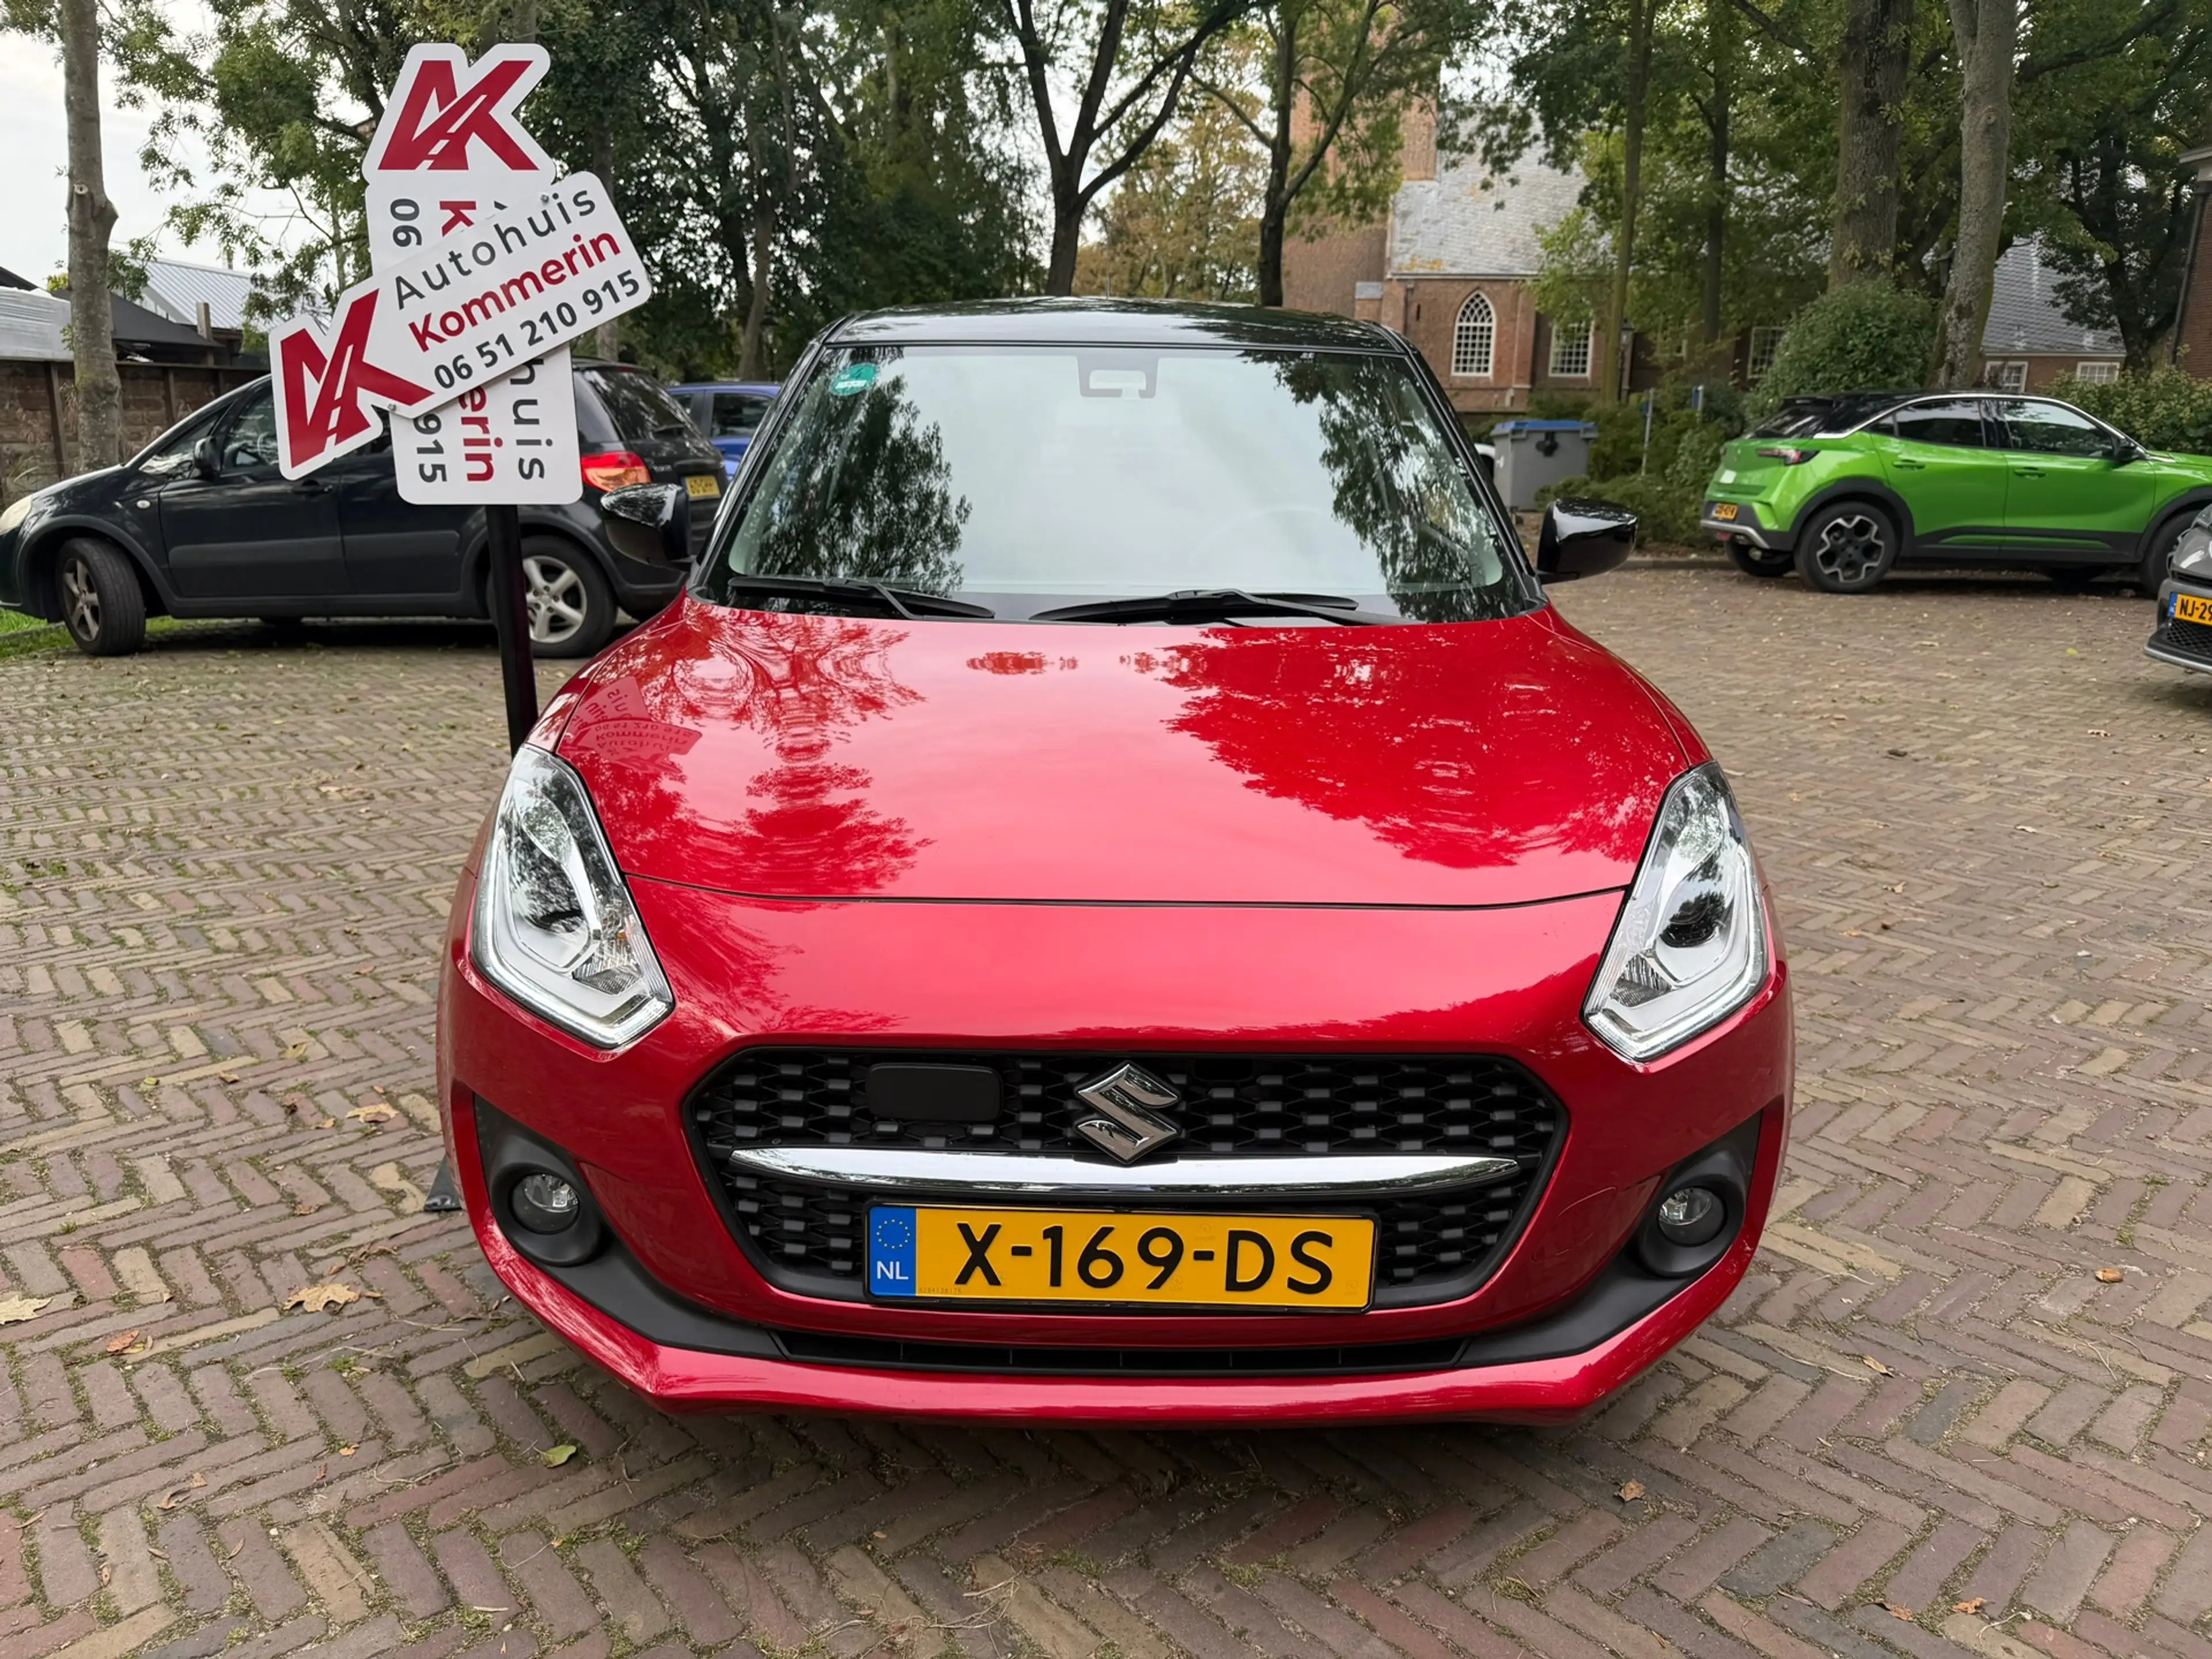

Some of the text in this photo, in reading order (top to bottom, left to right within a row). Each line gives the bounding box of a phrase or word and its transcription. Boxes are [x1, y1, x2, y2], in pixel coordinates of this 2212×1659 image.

[395, 190, 596, 310] Autohuis
[409, 232, 621, 353] Kommerin
[390, 198, 447, 483] 06 915
[434, 271, 639, 389] 06 51 210 915
[876, 1260, 909, 1281] NL
[953, 1222, 1333, 1295] X-169-DS
